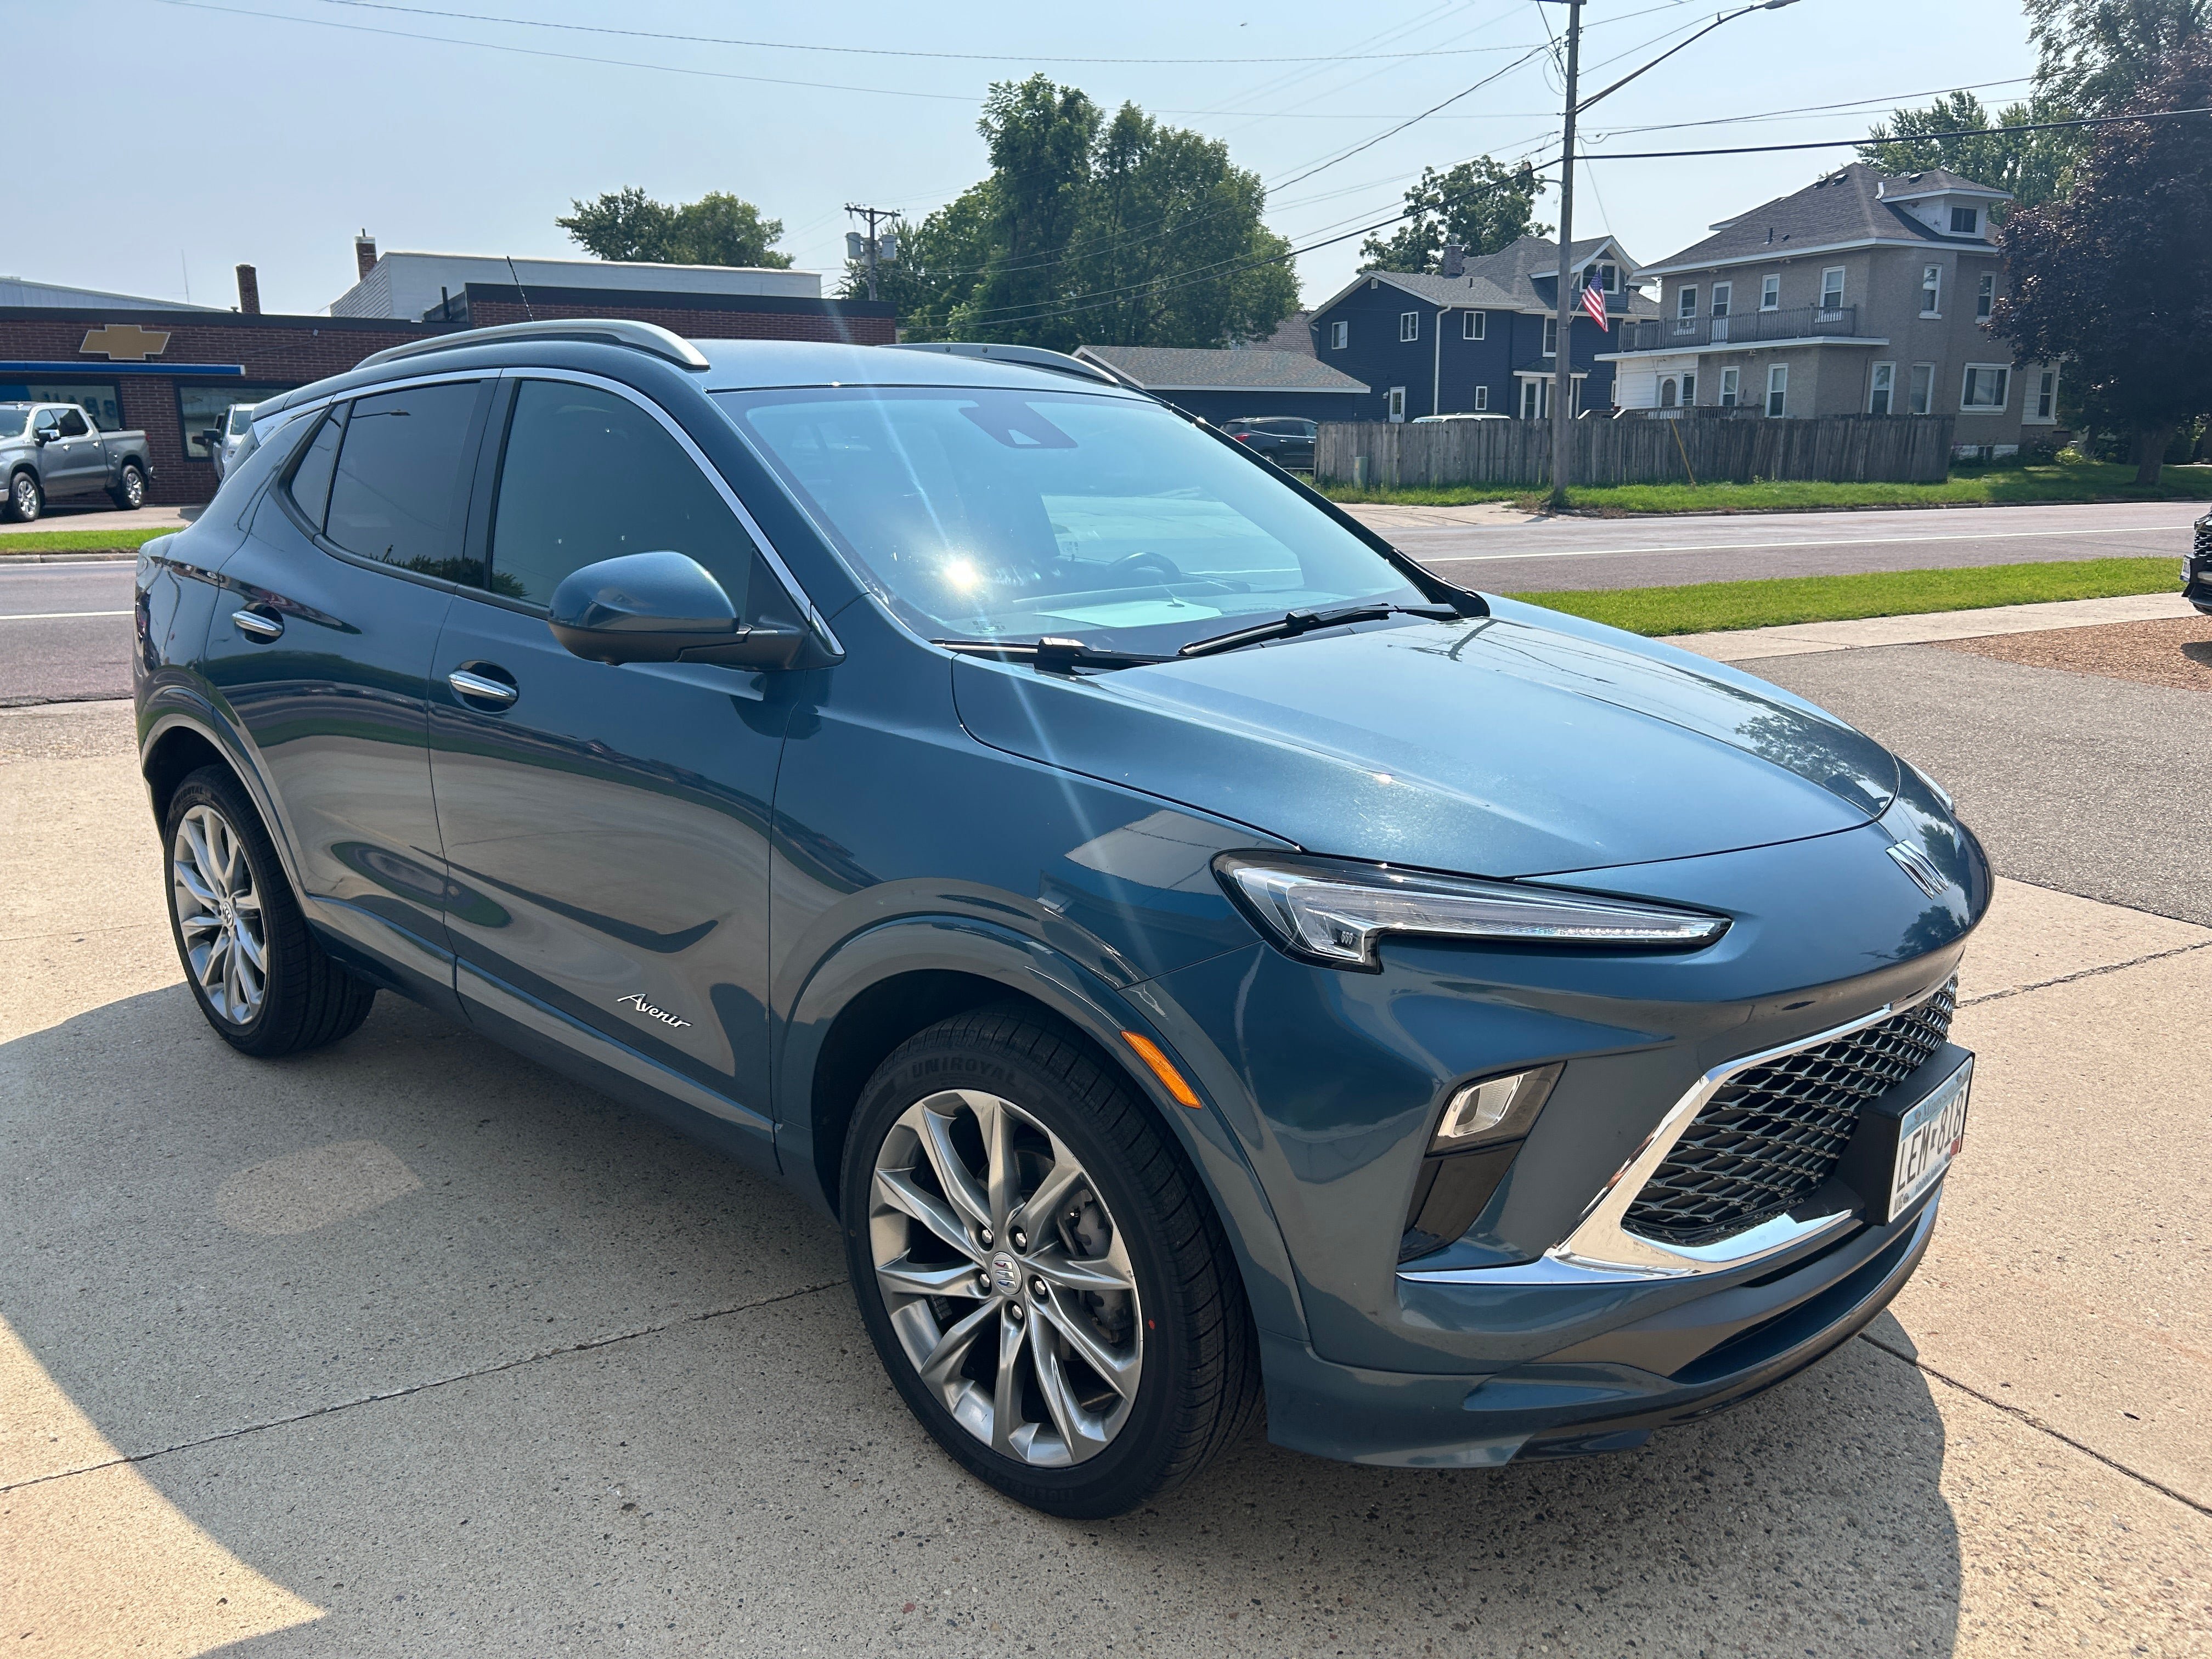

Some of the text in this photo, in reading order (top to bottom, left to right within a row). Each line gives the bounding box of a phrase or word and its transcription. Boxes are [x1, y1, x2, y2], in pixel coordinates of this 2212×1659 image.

[617, 992, 693, 1028] Avenir
[912, 1057, 1015, 1087] UNIROYAL
[1897, 1090, 1963, 1194] LEM 818
